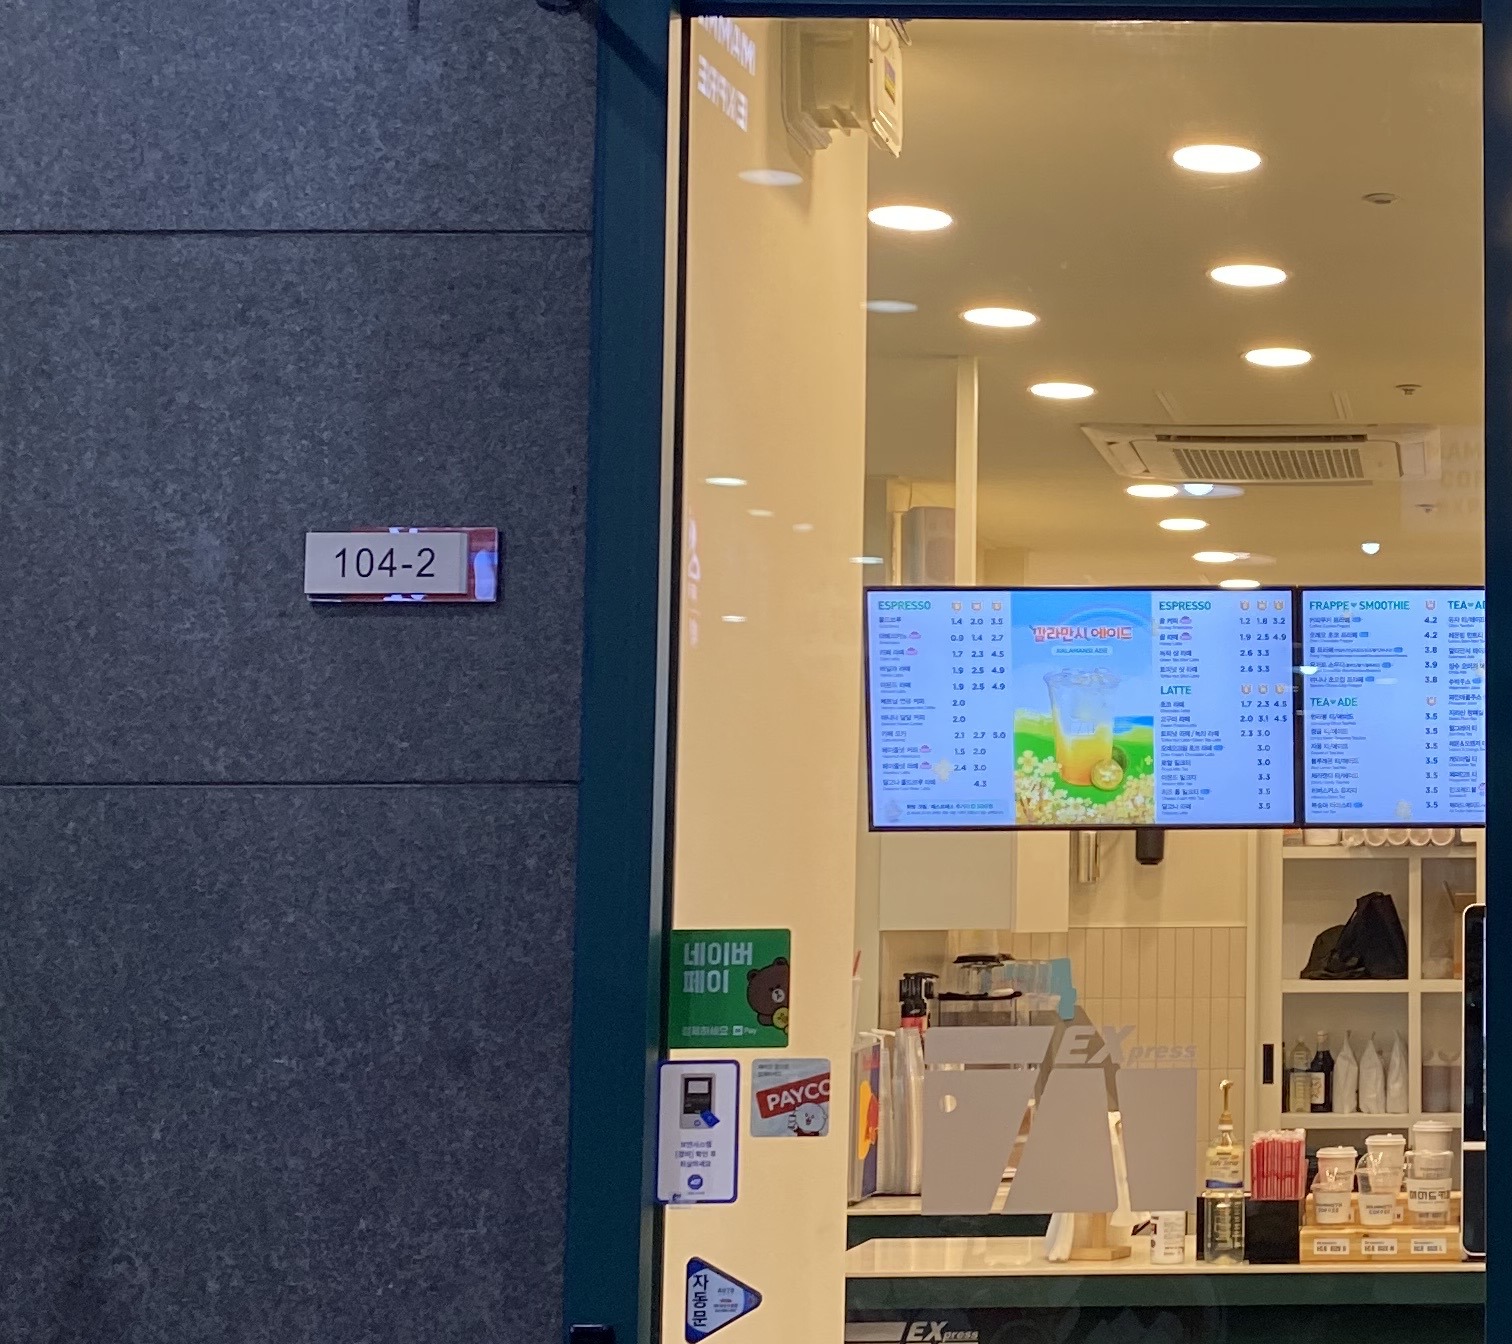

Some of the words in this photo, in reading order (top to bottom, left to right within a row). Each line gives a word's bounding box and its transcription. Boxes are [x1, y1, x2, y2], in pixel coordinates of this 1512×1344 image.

[335, 547, 436, 578] 104-2
[878, 600, 931, 610] ESPRESSO
[1159, 600, 1212, 610] ESPRESSO
[1309, 600, 1350, 610] FRAPPE
[1359, 600, 1410, 610] SMOOTHIE
[1448, 600, 1467, 610] TEA
[1424, 616, 1438, 624] 4.2
[1160, 686, 1192, 695] LATTE
[1310, 697, 1329, 706] TEA
[1338, 697, 1358, 706] ADE
[683, 941, 753, 966] 네이버
[683, 969, 730, 994] 페이
[692, 1274, 709, 1328] 자동문
